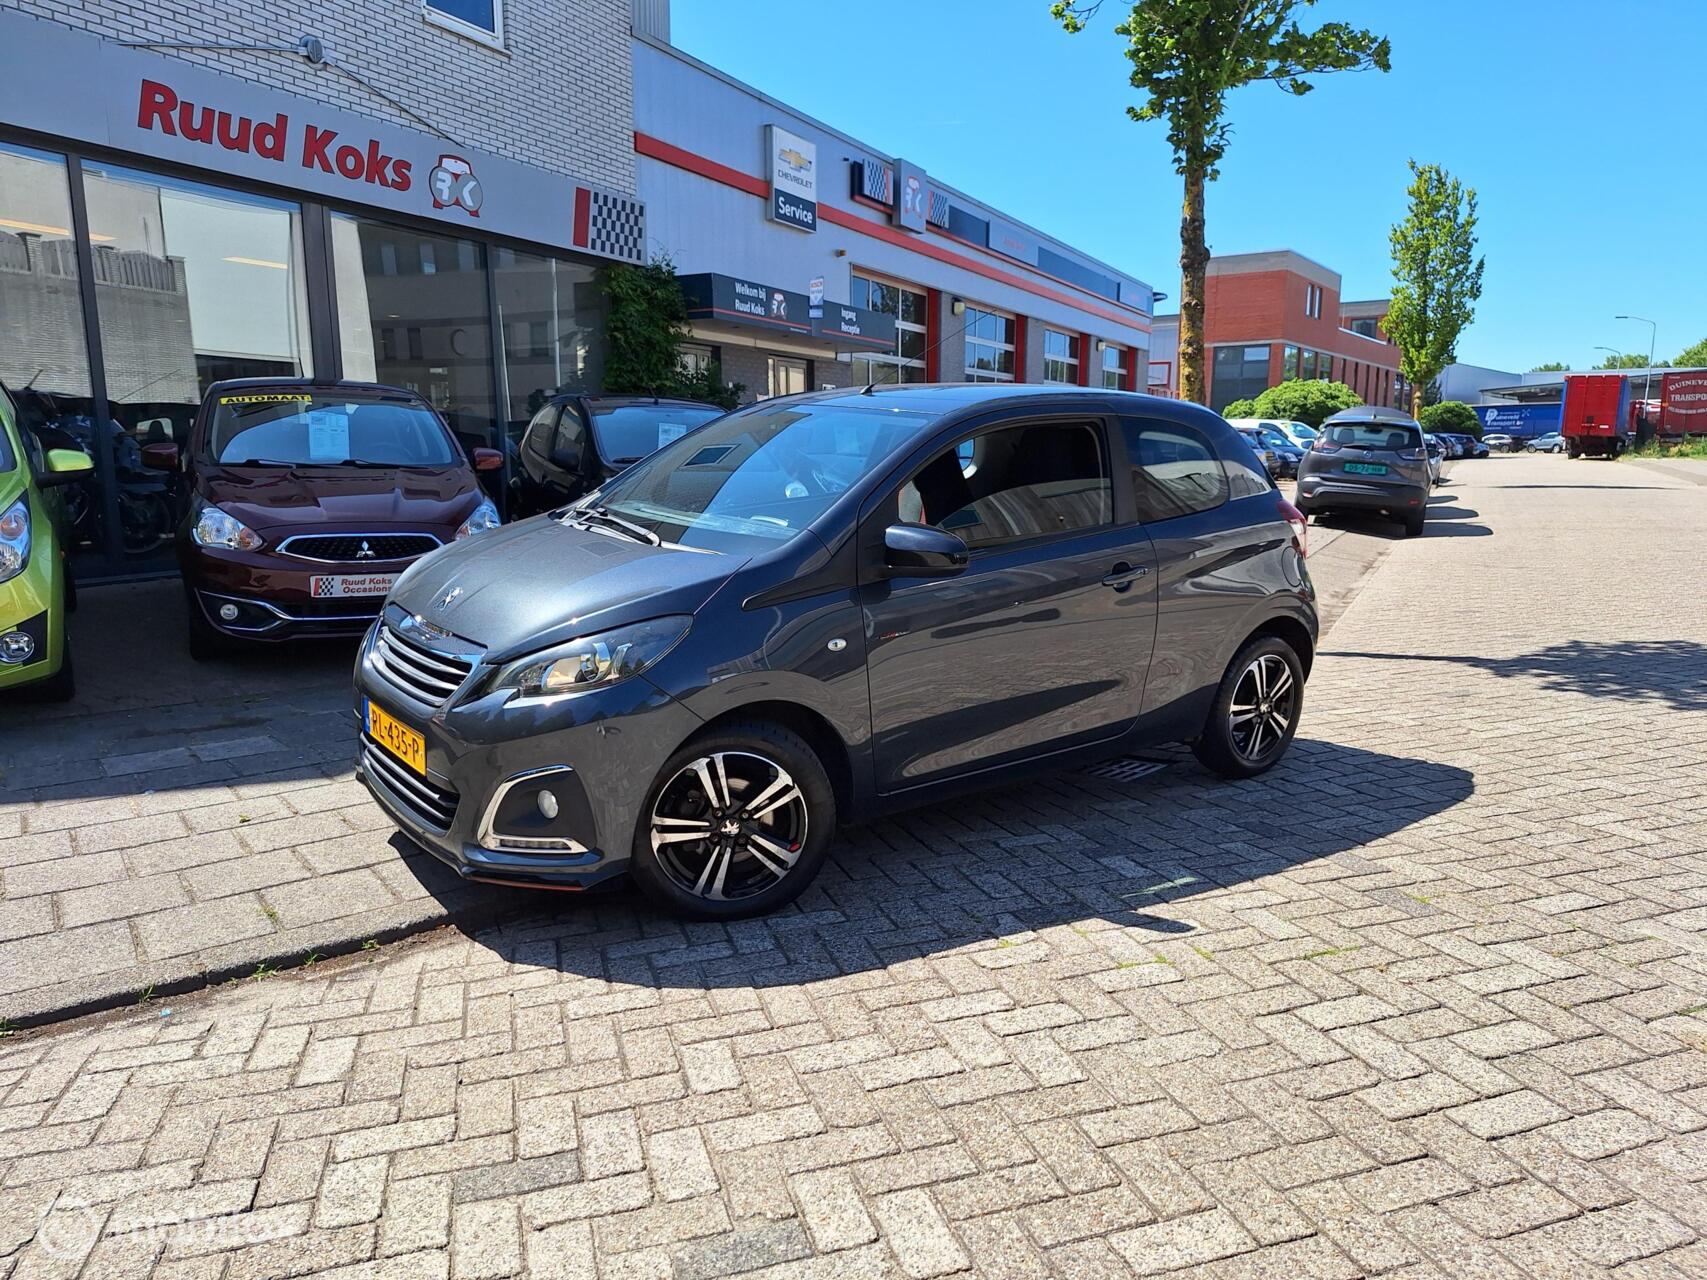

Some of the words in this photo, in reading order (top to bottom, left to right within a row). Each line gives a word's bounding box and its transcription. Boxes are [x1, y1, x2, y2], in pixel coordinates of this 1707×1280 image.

[137, 79, 289, 162] Ruud
[302, 124, 412, 192] Koks
[777, 169, 813, 190] CHEVROLET
[778, 196, 813, 225] Service
[735, 282, 758, 298] Welkom
[759, 287, 767, 302] bij
[735, 299, 750, 313] Ruud
[751, 301, 765, 316] Koks
[841, 307, 856, 322] Ingang
[841, 322, 860, 336] Receptie
[226, 395, 307, 404] AUTOMAAT
[341, 578, 366, 586] Ruud
[368, 577, 393, 585] Koks
[372, 708, 420, 764] RL-435-P
